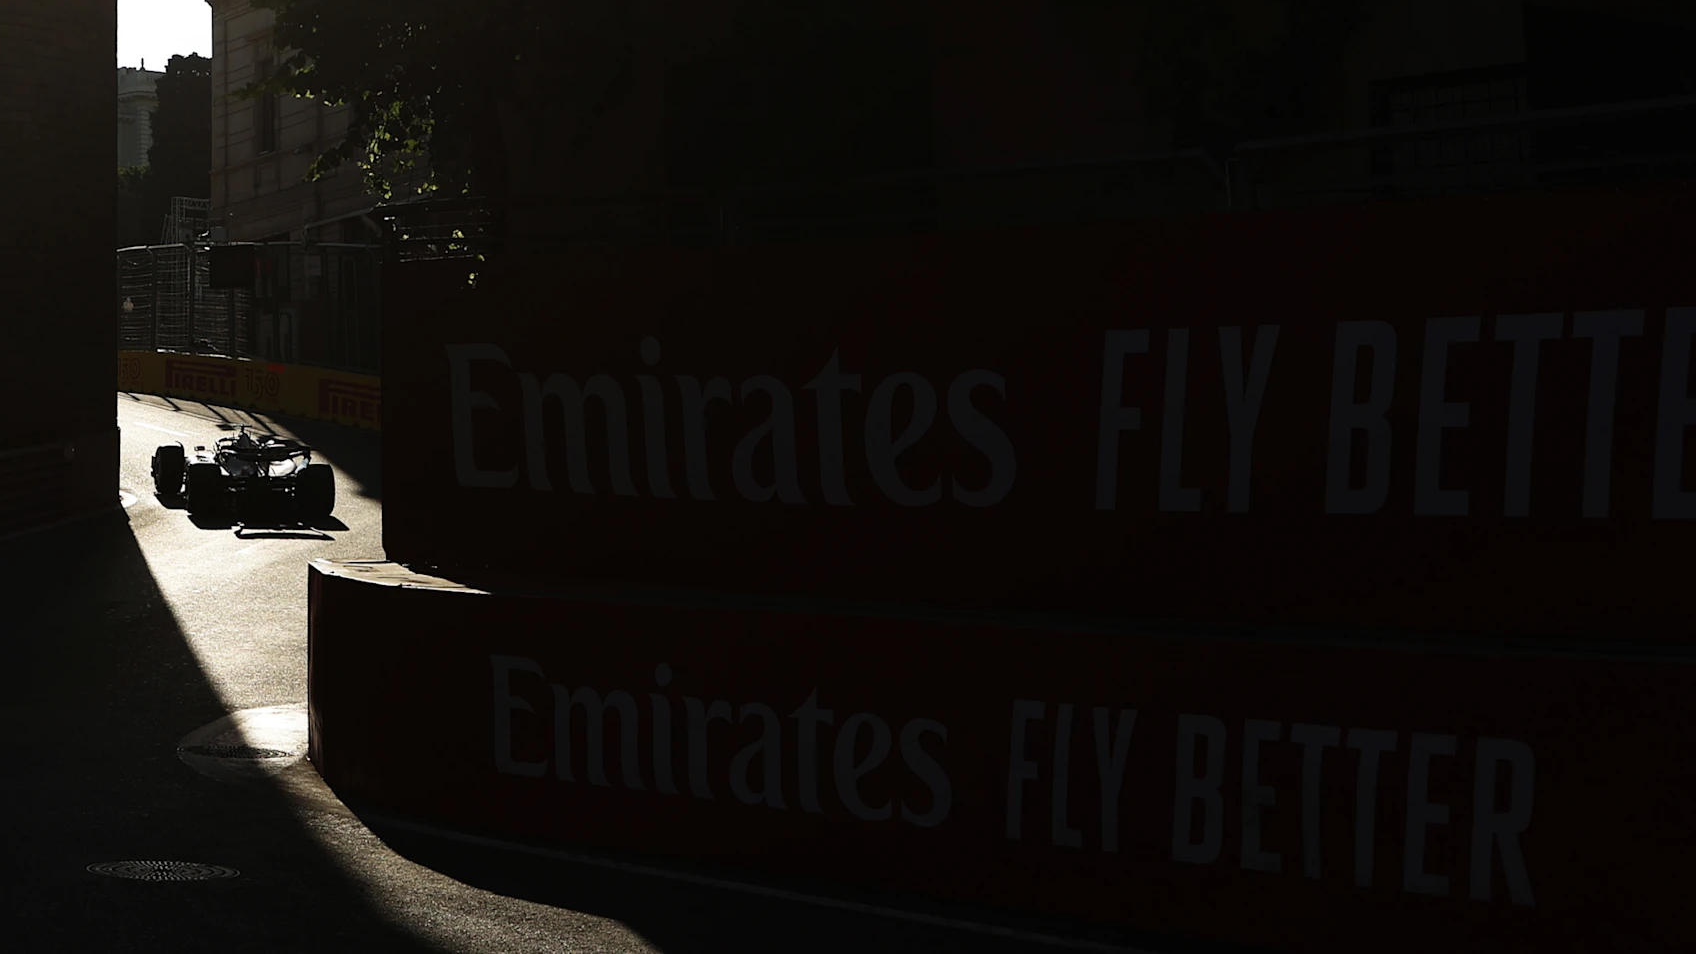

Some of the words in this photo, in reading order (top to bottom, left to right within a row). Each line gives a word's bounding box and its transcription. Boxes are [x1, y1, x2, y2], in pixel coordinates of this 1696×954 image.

[166, 359, 237, 396] PIRELLI
[246, 368, 280, 401] 150
[444, 335, 1017, 508] Emirates
[1095, 324, 1281, 514] FLY
[489, 653, 952, 829] Emirates
[1006, 698, 1138, 853] FLY
[1172, 713, 1536, 906] BETTER
